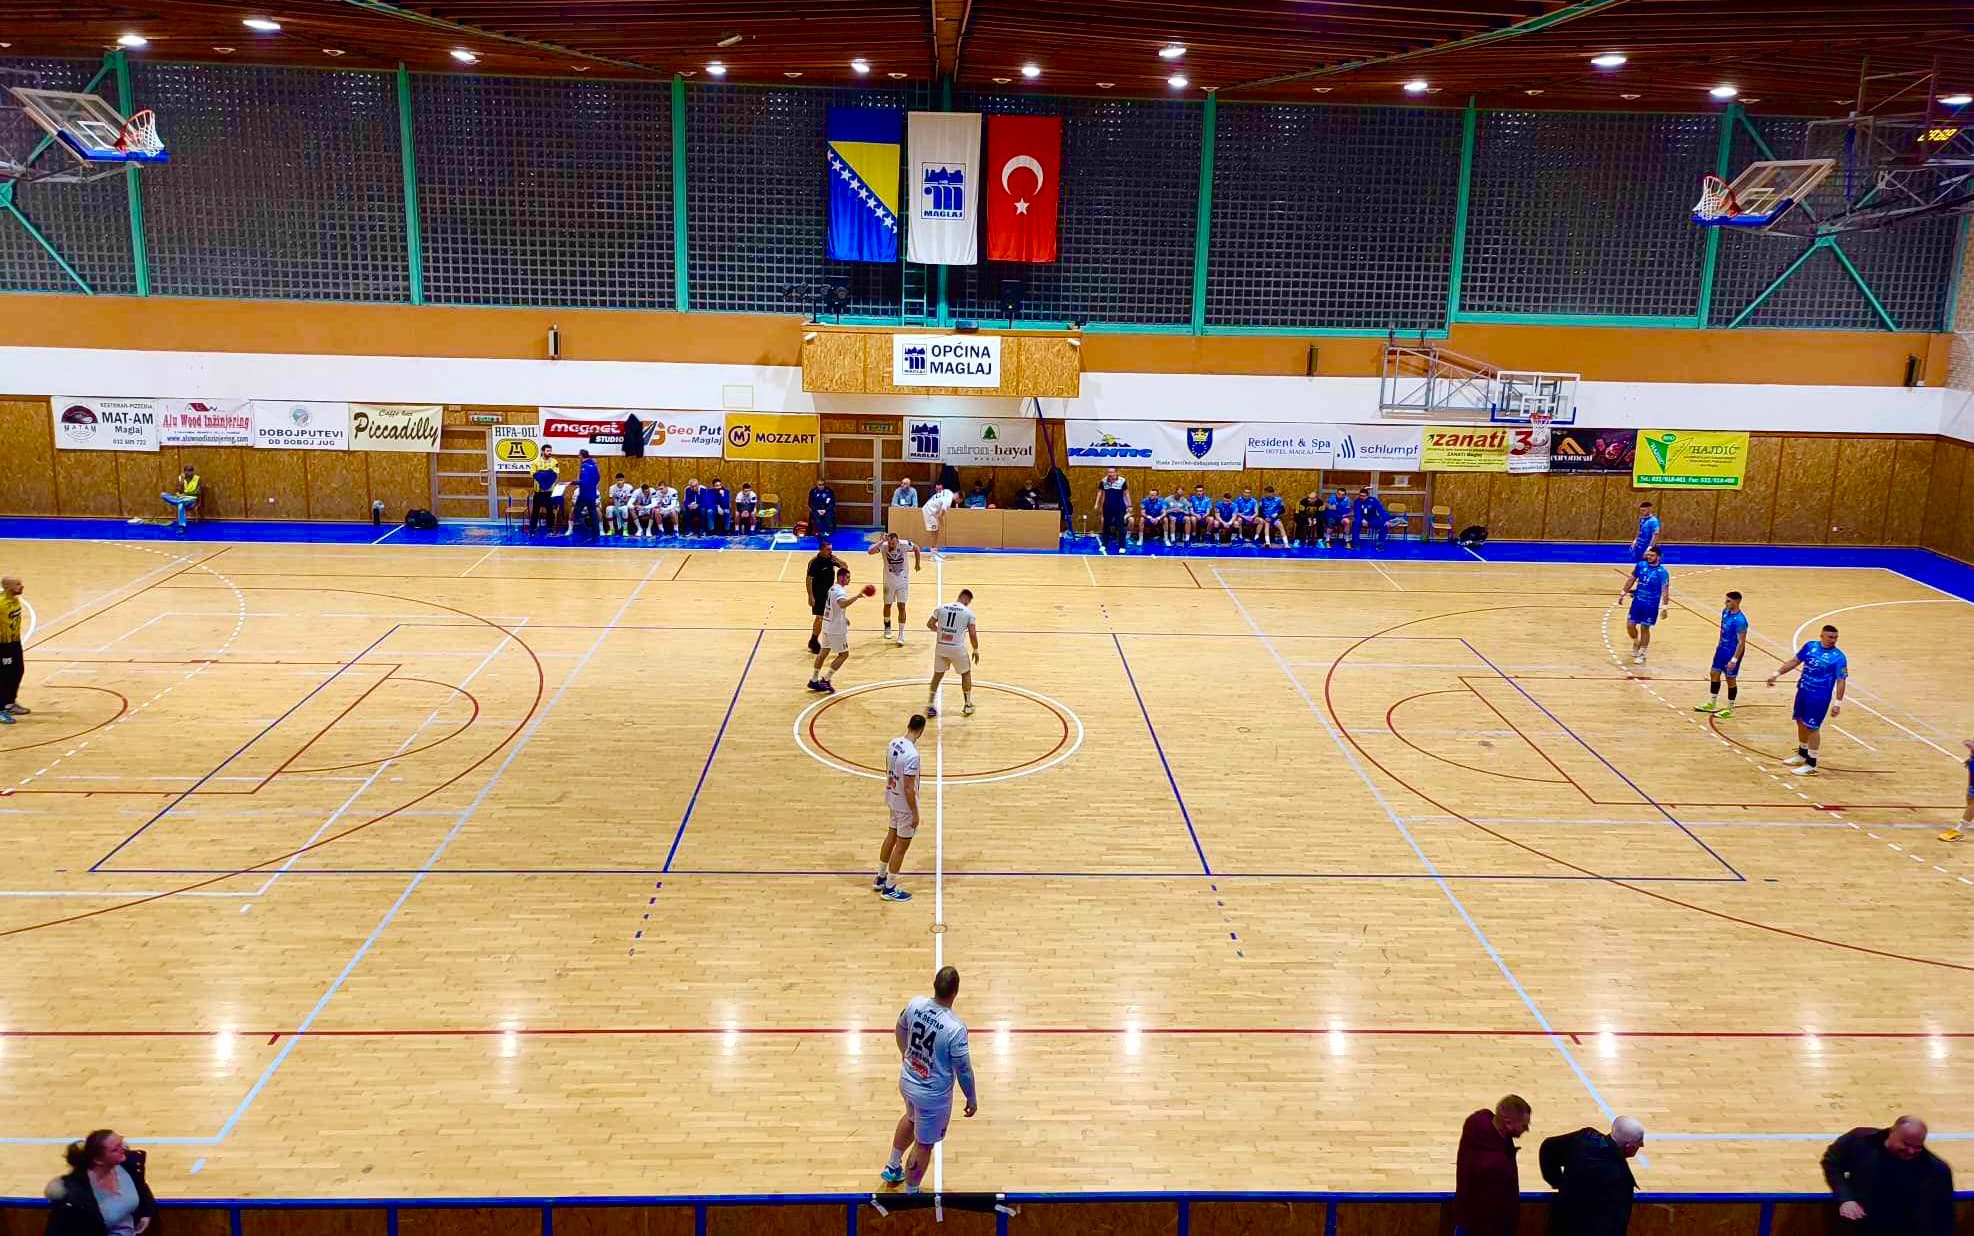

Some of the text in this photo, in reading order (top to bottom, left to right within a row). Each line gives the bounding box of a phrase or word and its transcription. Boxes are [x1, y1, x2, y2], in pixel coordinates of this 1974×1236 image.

[923, 210, 963, 218] MAGLAJ
[931, 341, 991, 359] OPĆINA
[930, 361, 992, 375] MAGLAJ
[101, 412, 153, 425] MAT-AM
[163, 414, 178, 428] Alu
[180, 414, 202, 428] Wood
[114, 425, 143, 435] Maglaj
[259, 429, 343, 438] DOBOJPUTEVI
[353, 412, 439, 447] Piccadilly
[495, 427, 537, 438] HIFA-OIL
[551, 422, 621, 435] magnet
[667, 425, 722, 436] Geo Put
[595, 435, 625, 443] STUDIO
[691, 436, 722, 446] Maglaj
[755, 433, 816, 444] MOZZART
[1248, 437, 1331, 450] Resident & Spa
[1432, 429, 1507, 448] zanati
[1360, 444, 1419, 456] schlumpf
[946, 611, 957, 628] 11
[911, 1021, 937, 1058] 24
